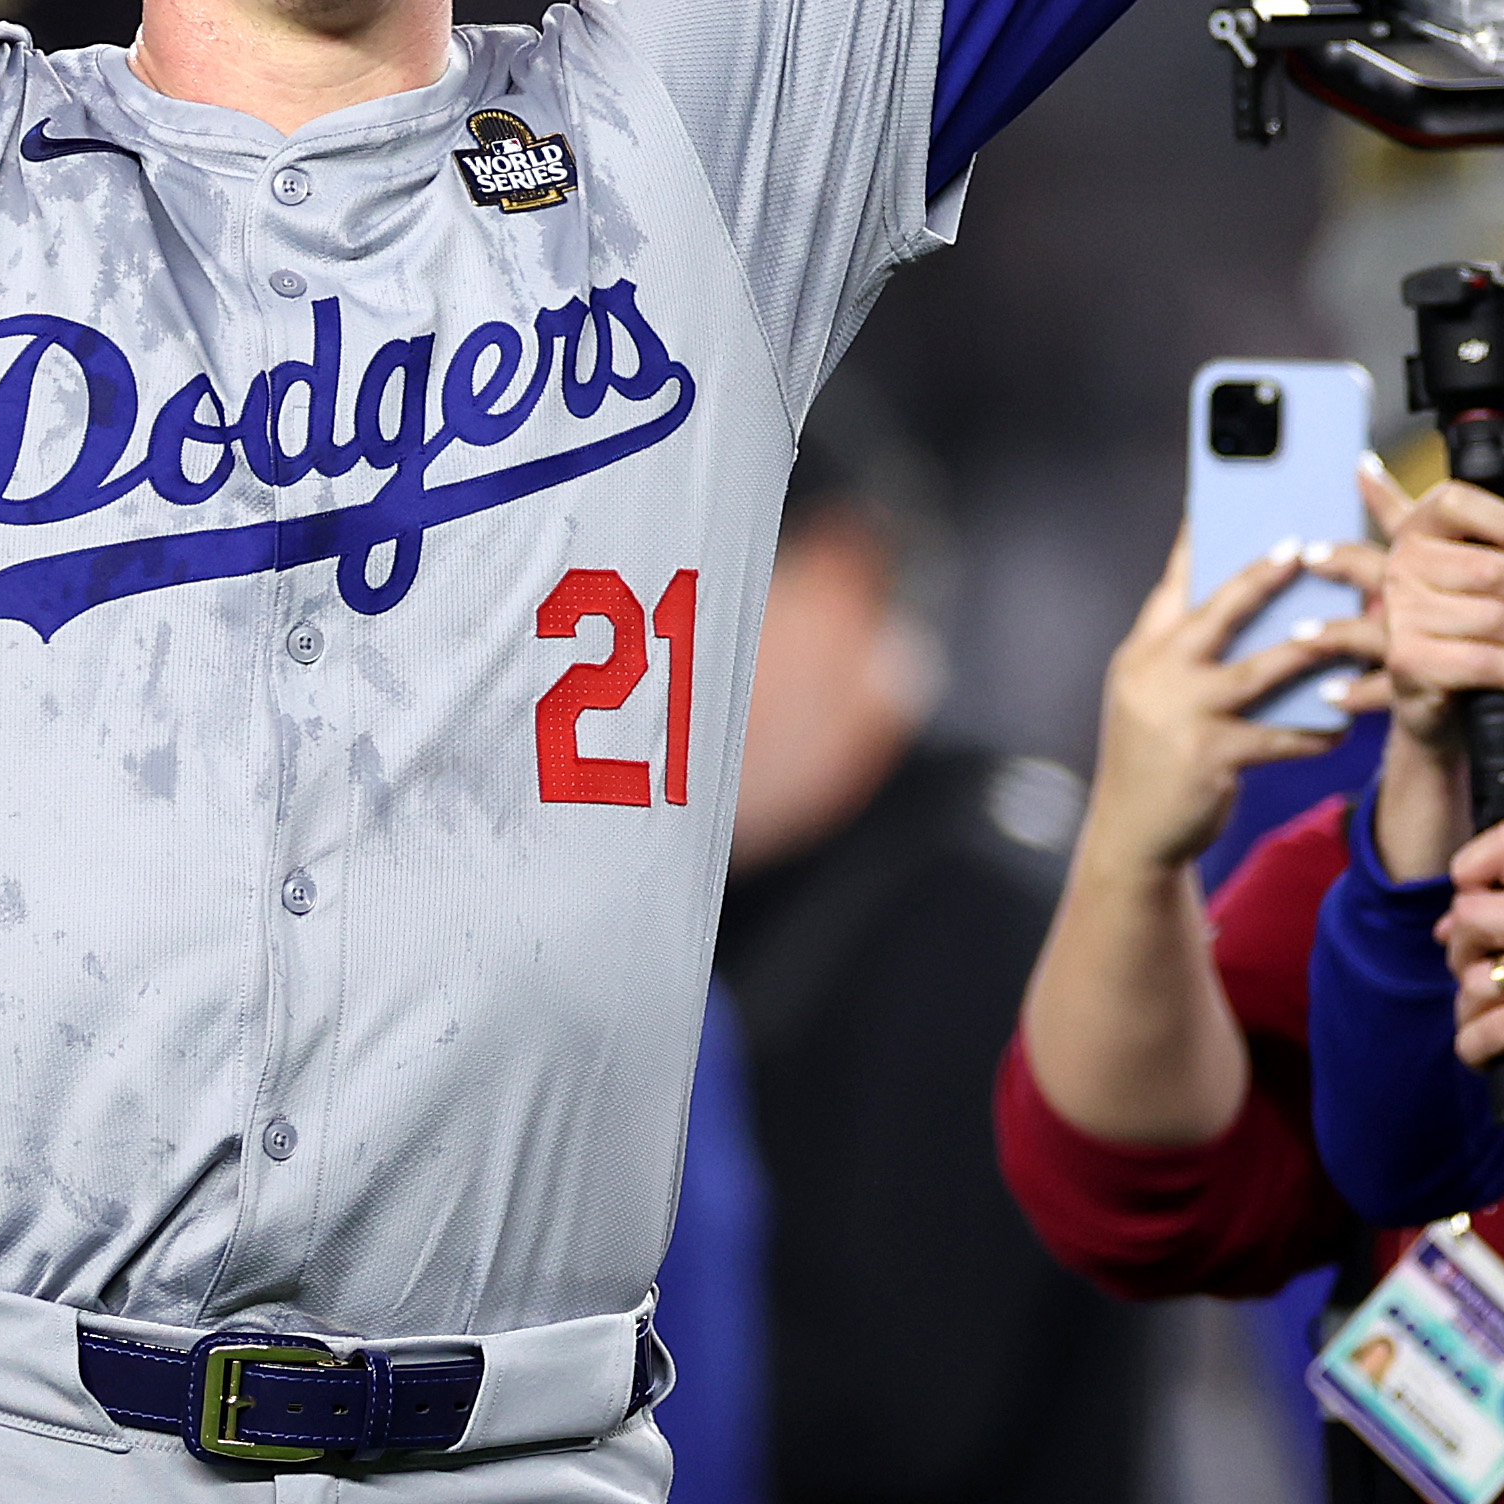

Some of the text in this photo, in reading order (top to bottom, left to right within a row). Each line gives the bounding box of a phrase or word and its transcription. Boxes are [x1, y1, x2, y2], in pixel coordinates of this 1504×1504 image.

[462, 145, 563, 176] WORLD
[476, 162, 568, 193] SERIES
[532, 568, 701, 808] 21
